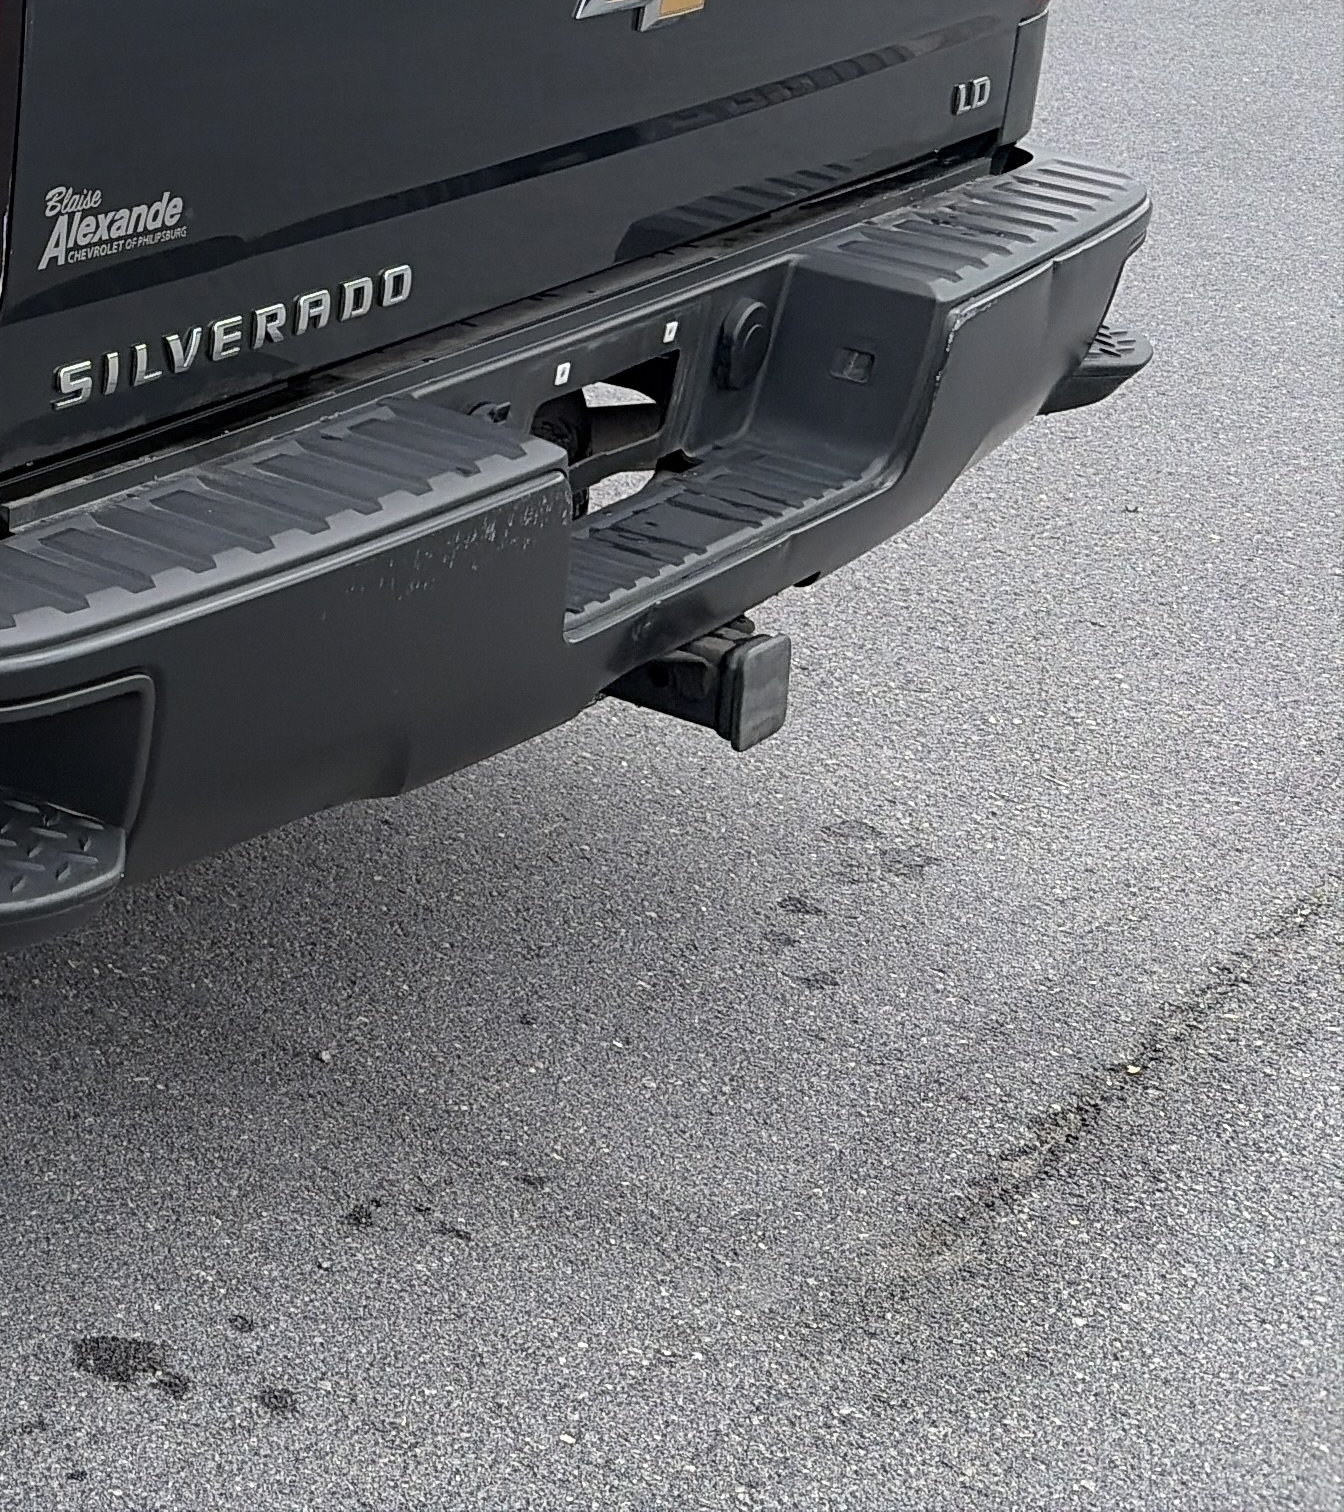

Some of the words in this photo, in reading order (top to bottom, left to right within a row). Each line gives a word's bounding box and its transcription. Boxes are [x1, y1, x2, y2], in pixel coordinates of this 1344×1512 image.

[952, 76, 991, 115] LD
[45, 186, 102, 217] Blaise
[37, 191, 184, 270] Alexande
[67, 240, 125, 263] CHEVROLET
[125, 237, 138, 250] OF
[137, 226, 187, 247] PHILIPSBURG
[51, 264, 412, 411] SILVERADO
